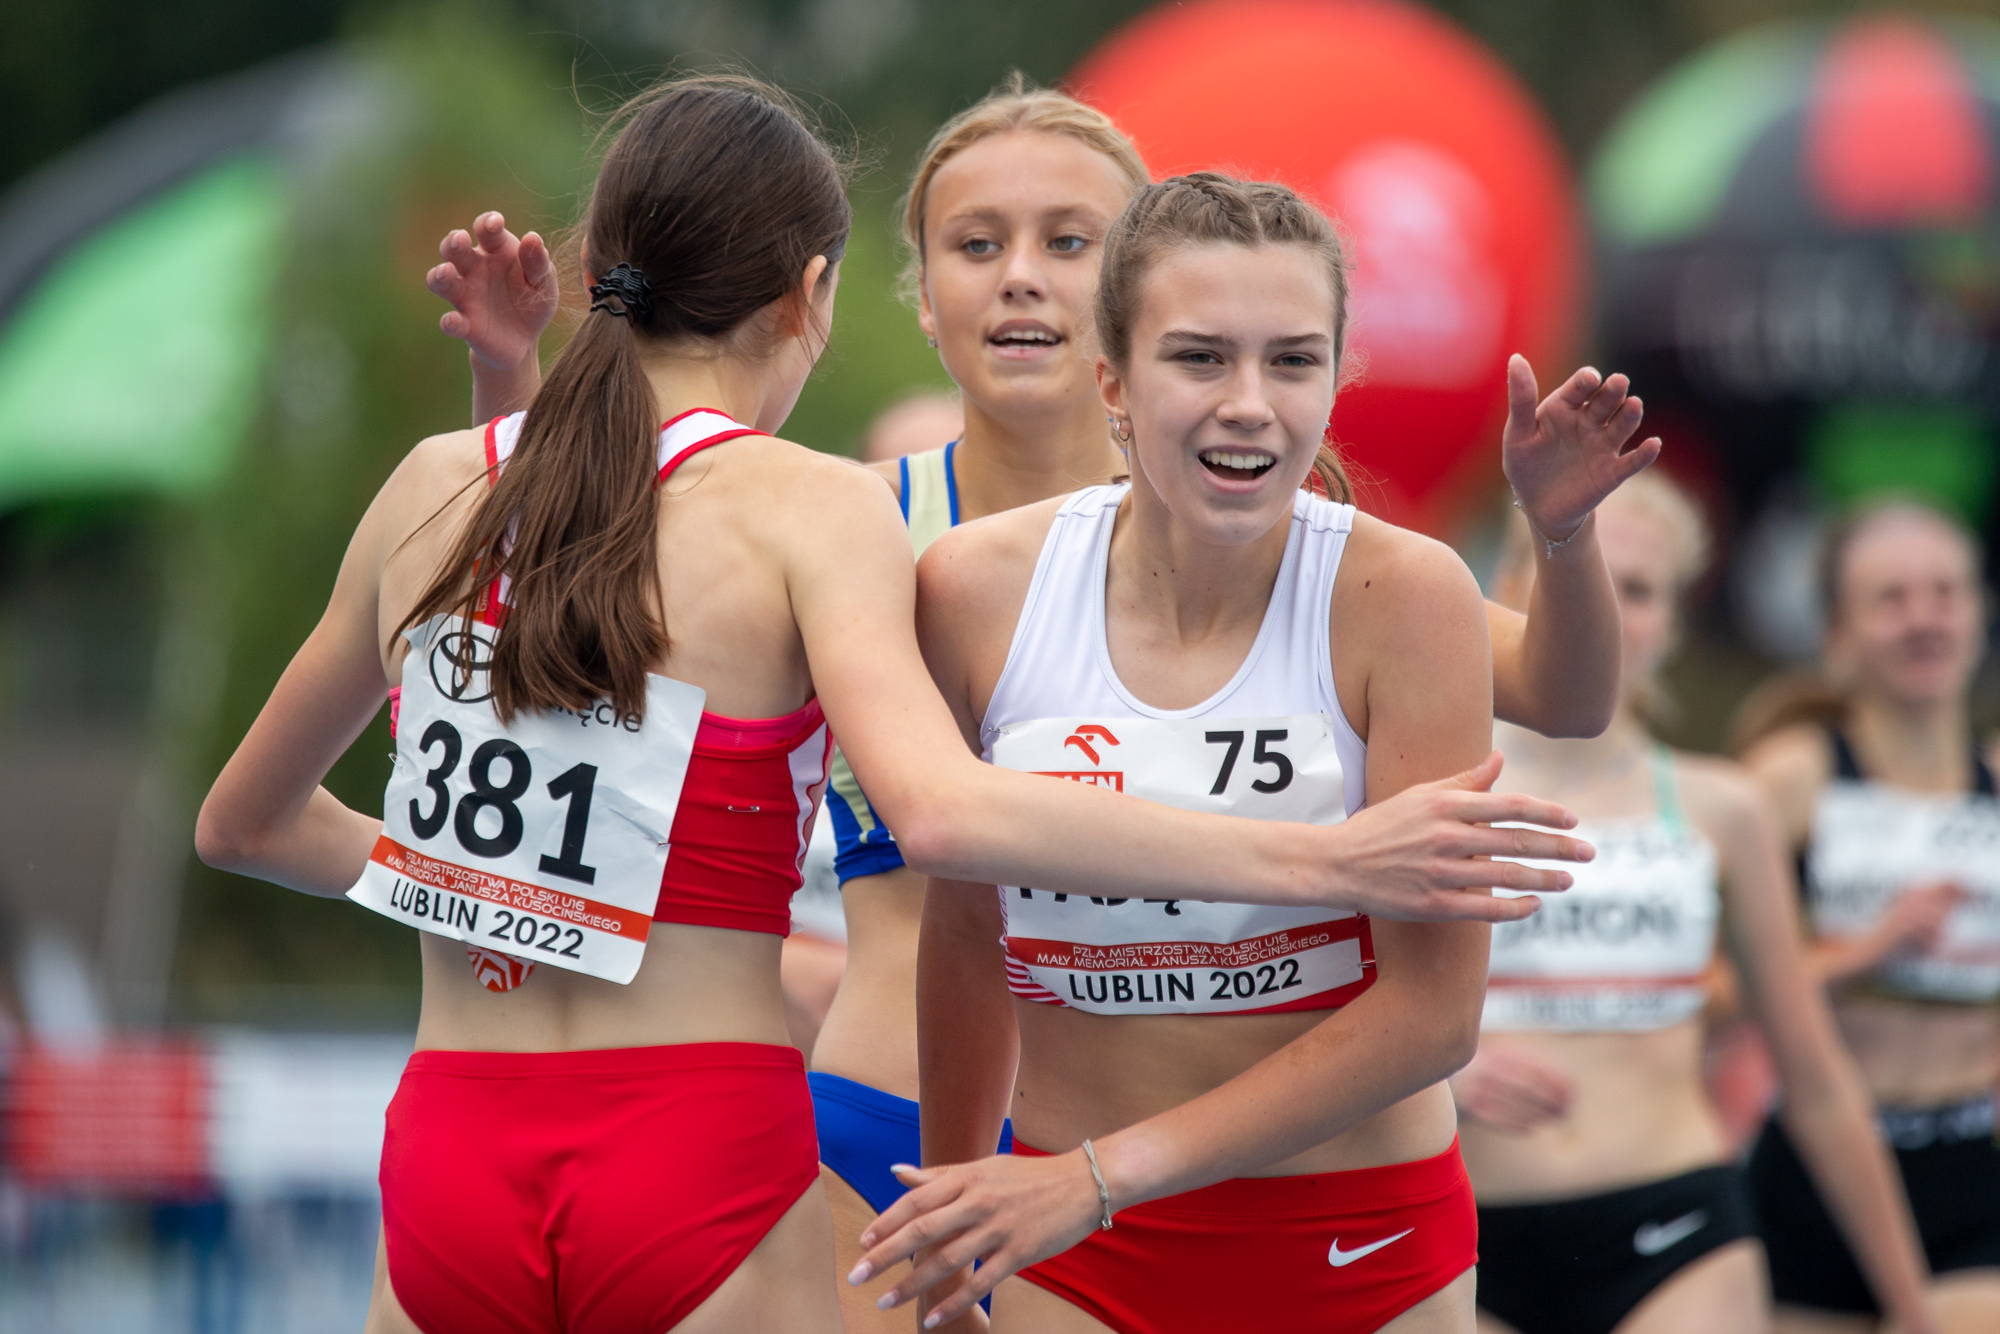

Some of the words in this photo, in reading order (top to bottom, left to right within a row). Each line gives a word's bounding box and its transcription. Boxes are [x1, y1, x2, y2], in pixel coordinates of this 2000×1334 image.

[1205, 729, 1294, 796] 75
[409, 720, 599, 886] 381
[421, 858, 507, 893] MISTRZOSTWA
[509, 882, 559, 904] POLSKI
[561, 896, 586, 912] U16
[449, 879, 510, 904] JANUSZA
[390, 878, 480, 933] LUBLIN
[488, 910, 585, 960] 2022
[1036, 953, 1071, 966] MAŁY
[1073, 957, 1148, 969] MEMORIAŁ
[1151, 955, 1218, 967] JANUSZA
[1072, 945, 1106, 959] PZLA
[1109, 944, 1212, 958] MISTRZOSTWA
[1213, 940, 1262, 957] POLSKI
[1264, 933, 1289, 948] U16
[1068, 973, 1195, 1003] LUBLIN
[1209, 959, 1303, 1000] 2022
